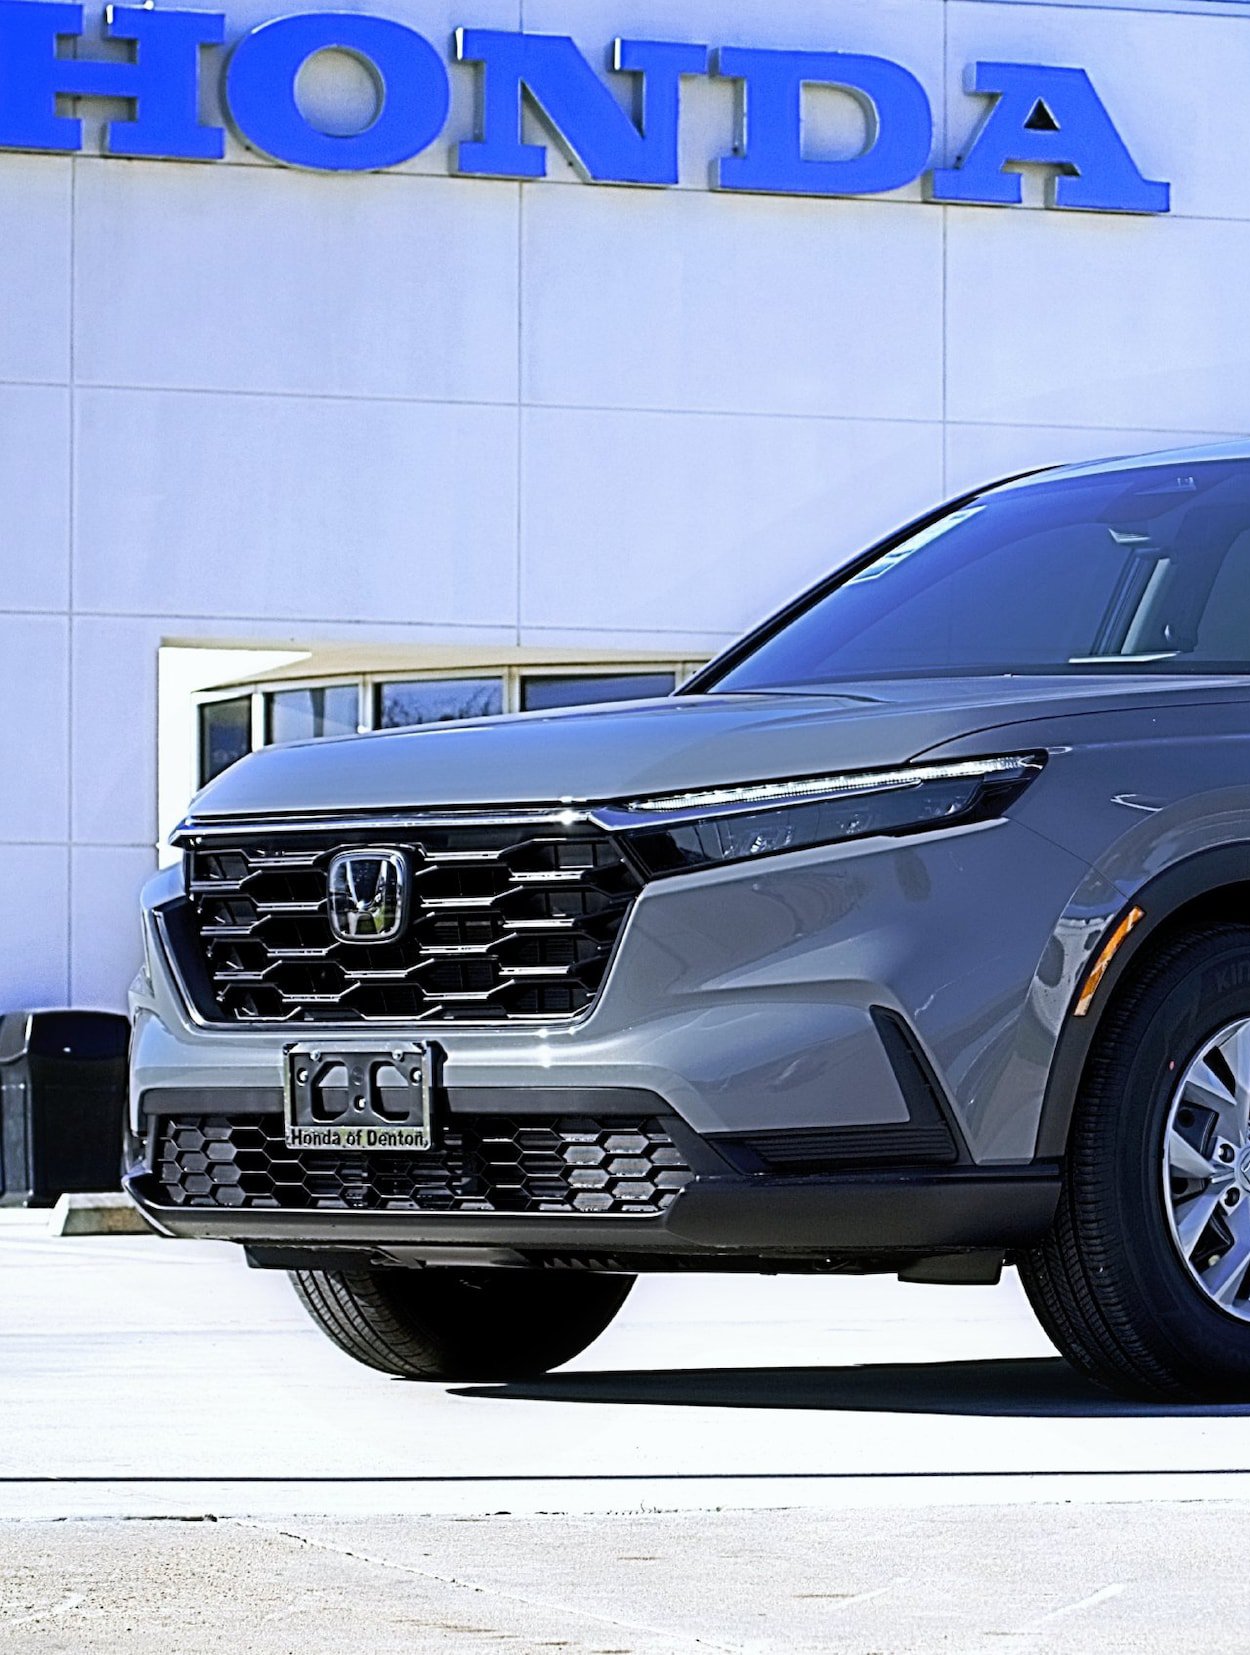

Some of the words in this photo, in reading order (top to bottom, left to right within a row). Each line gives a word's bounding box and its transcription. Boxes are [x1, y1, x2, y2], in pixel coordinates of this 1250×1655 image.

[0, 2, 1171, 213] HONDA
[291, 1129, 341, 1146] Honda
[346, 1129, 363, 1146] of
[367, 1129, 424, 1147] Denton
